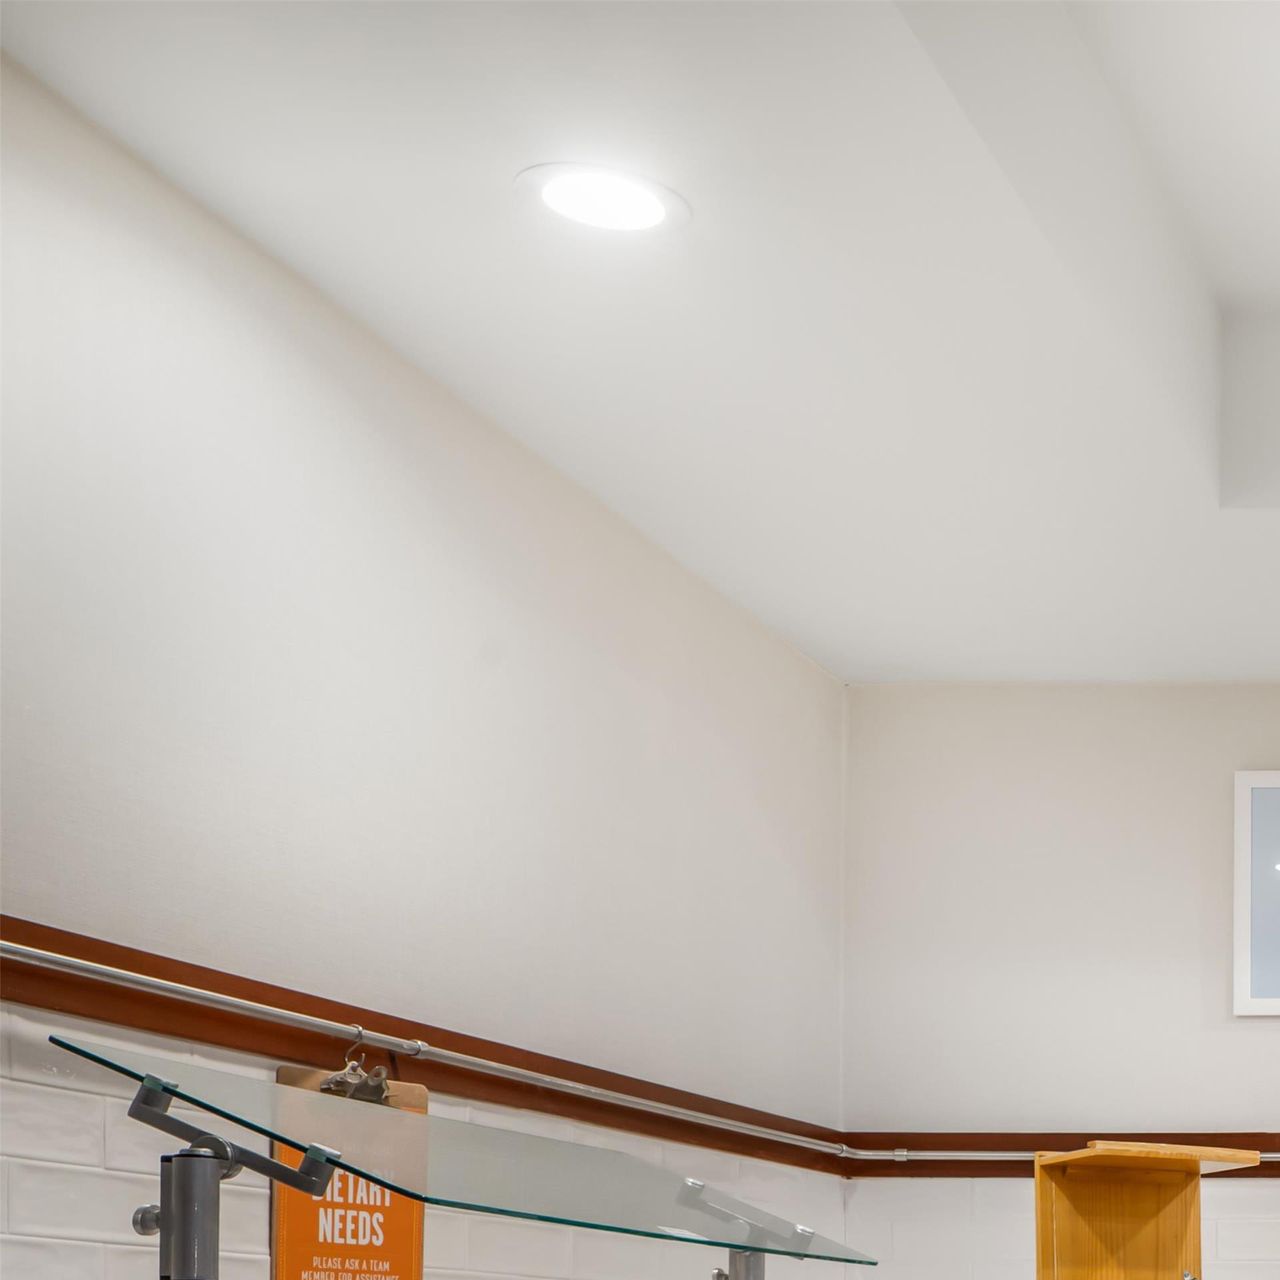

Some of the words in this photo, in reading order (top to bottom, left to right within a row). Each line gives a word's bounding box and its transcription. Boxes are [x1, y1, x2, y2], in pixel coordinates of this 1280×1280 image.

[318, 1207, 384, 1247] NEEDS
[312, 1256, 342, 1270] PLEASE
[345, 1258, 360, 1271] ASK
[362, 1259, 368, 1271] A
[370, 1259, 390, 1272] TEAM
